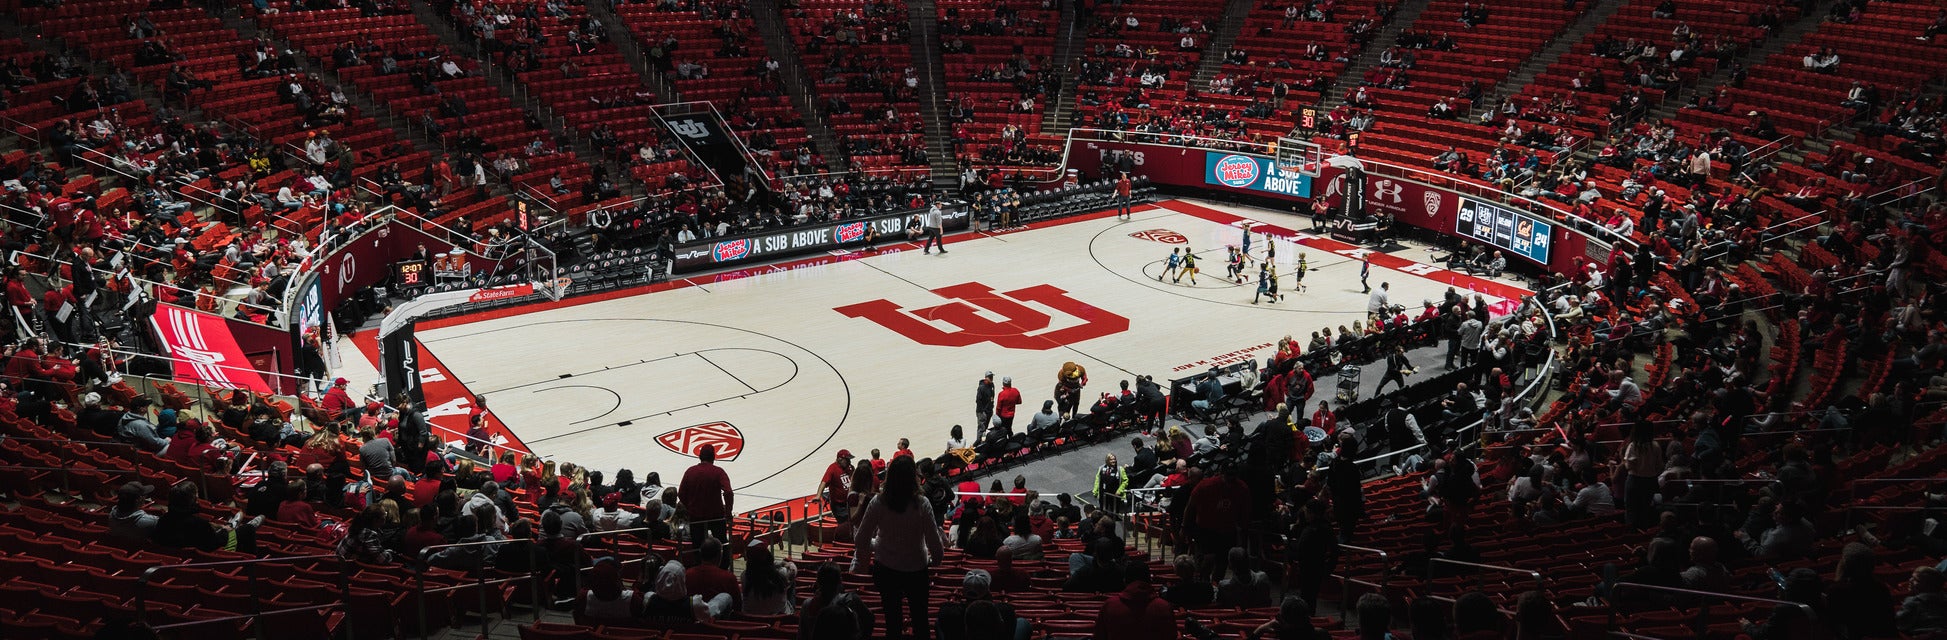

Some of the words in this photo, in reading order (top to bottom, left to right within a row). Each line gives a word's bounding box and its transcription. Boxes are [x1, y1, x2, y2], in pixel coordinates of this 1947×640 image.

[1302, 116, 1314, 128] 30
[1221, 161, 1253, 172] Jersey
[1267, 161, 1275, 176] A
[1264, 176, 1301, 195] ABOVE
[1460, 207, 1474, 222] 29
[881, 217, 901, 234] SUB
[1517, 220, 1532, 237] Cal
[718, 239, 745, 254] Jersey
[753, 239, 761, 254] A
[765, 234, 788, 252] SUB
[792, 228, 830, 248] ABOVE
[1533, 232, 1548, 248] 24
[402, 264, 421, 273] 12:07
[405, 272, 418, 283] 30
[1211, 342, 1274, 361] HUNTSMAN
